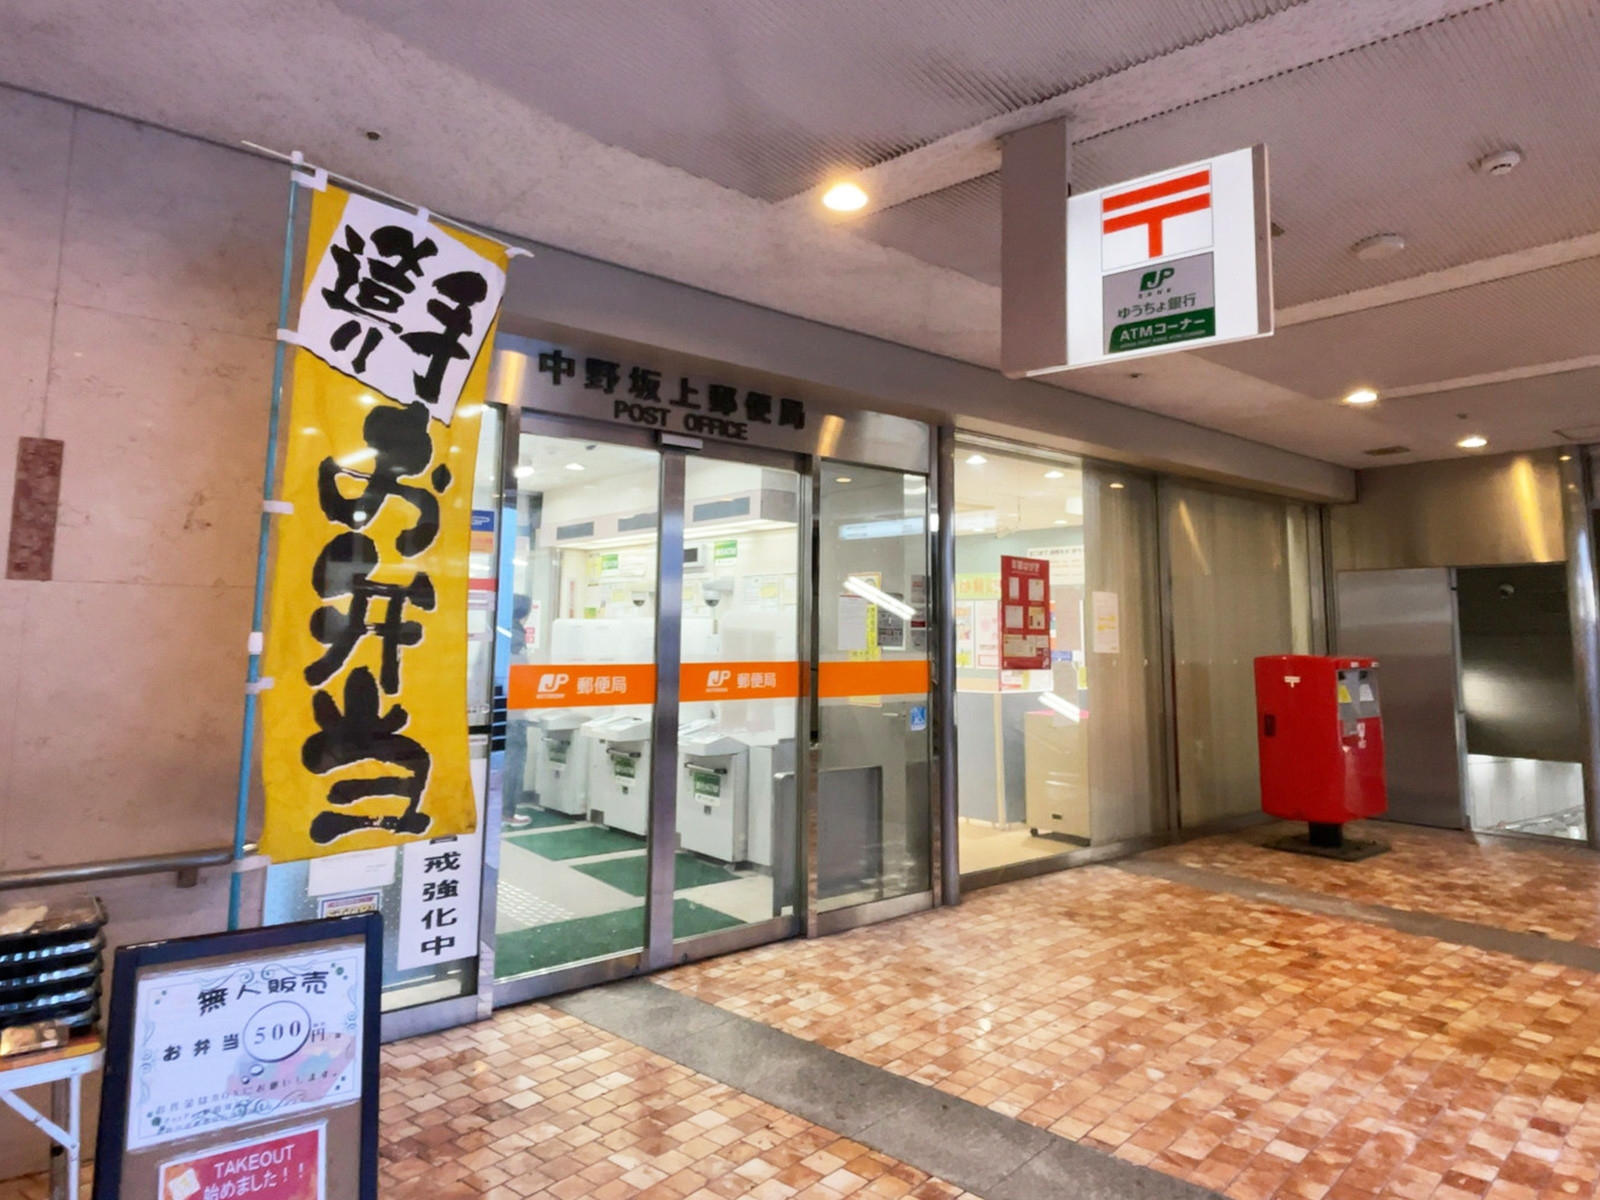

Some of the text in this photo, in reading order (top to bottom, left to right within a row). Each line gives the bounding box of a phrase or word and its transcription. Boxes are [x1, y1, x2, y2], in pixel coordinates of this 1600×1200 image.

[1140, 267, 1175, 291] JP
[1117, 292, 1197, 320] ゆうちょ銀行
[1119, 317, 1206, 343] ATMコーナー
[538, 348, 806, 431] 中野坂上郵便局
[613, 399, 748, 441] POST OFFICE
[301, 400, 452, 844] お弁当
[537, 673, 627, 695] JP 郵便局
[706, 669, 777, 689] JP 郵便局
[420, 834, 461, 956] 戒強化中
[197, 970, 329, 1017] 無人販売
[163, 1032, 239, 1062] お弁当
[253, 1019, 301, 1046] 500
[213, 1143, 295, 1180] TAKEOUT
